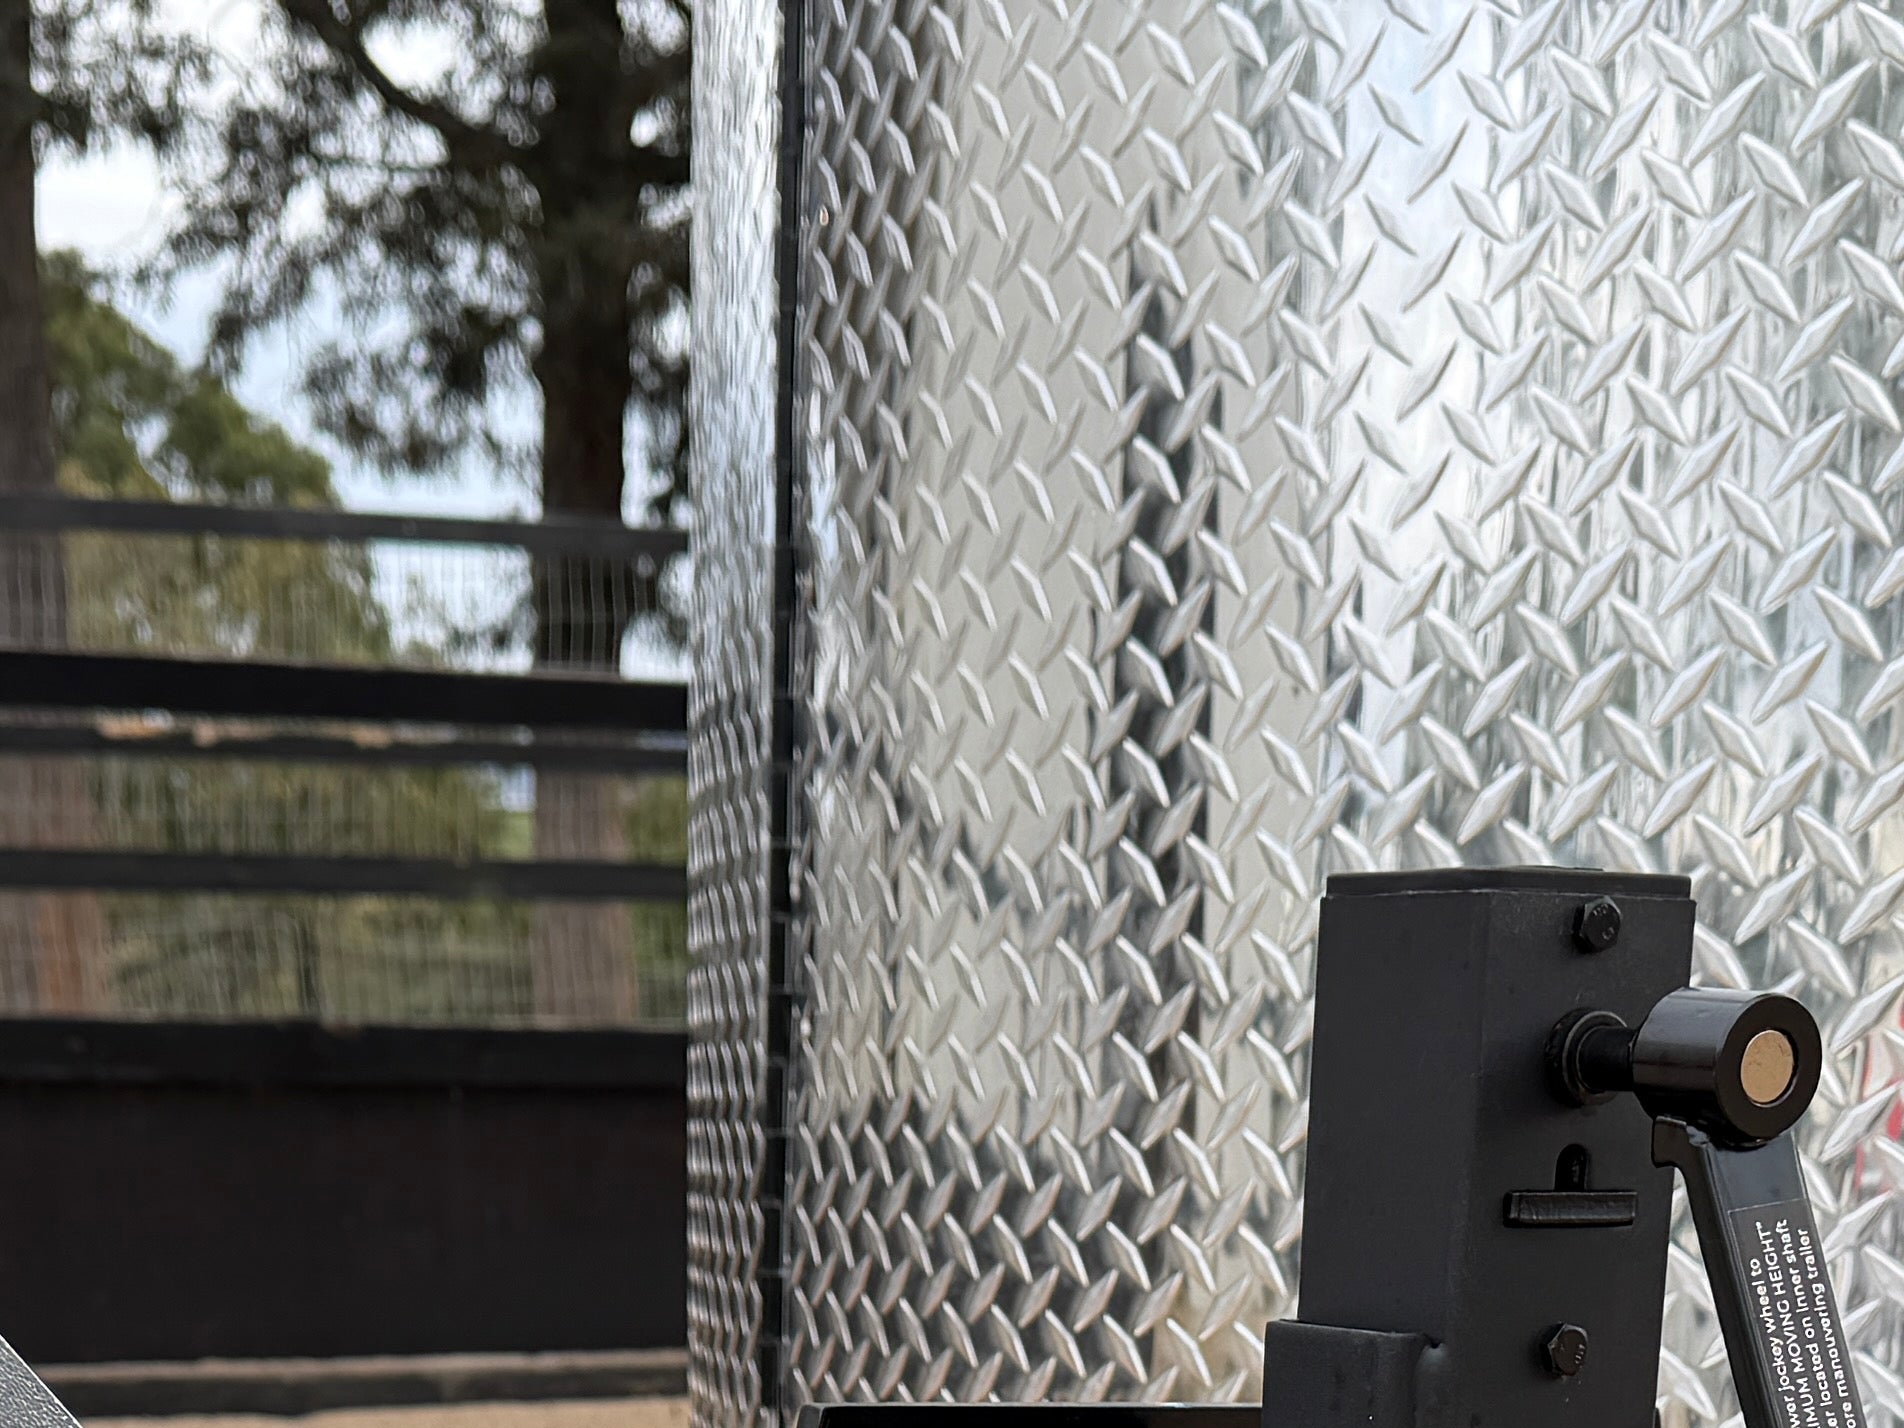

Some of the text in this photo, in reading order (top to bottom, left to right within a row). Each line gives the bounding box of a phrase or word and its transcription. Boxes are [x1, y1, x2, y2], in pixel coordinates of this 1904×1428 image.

[1750, 1258, 1762, 1276] to
[1775, 1219, 1797, 1263] shaft
[1796, 1228, 1819, 1279] trailer
[1752, 1280, 1777, 1333] wheel
[1787, 1267, 1808, 1312] inner
[1777, 1300, 1805, 1372] MOVING
[1800, 1316, 1814, 1339] on
[1812, 1282, 1849, 1397] manouvering
[1768, 1338, 1795, 1391] jockey
[1806, 1343, 1832, 1406] located
